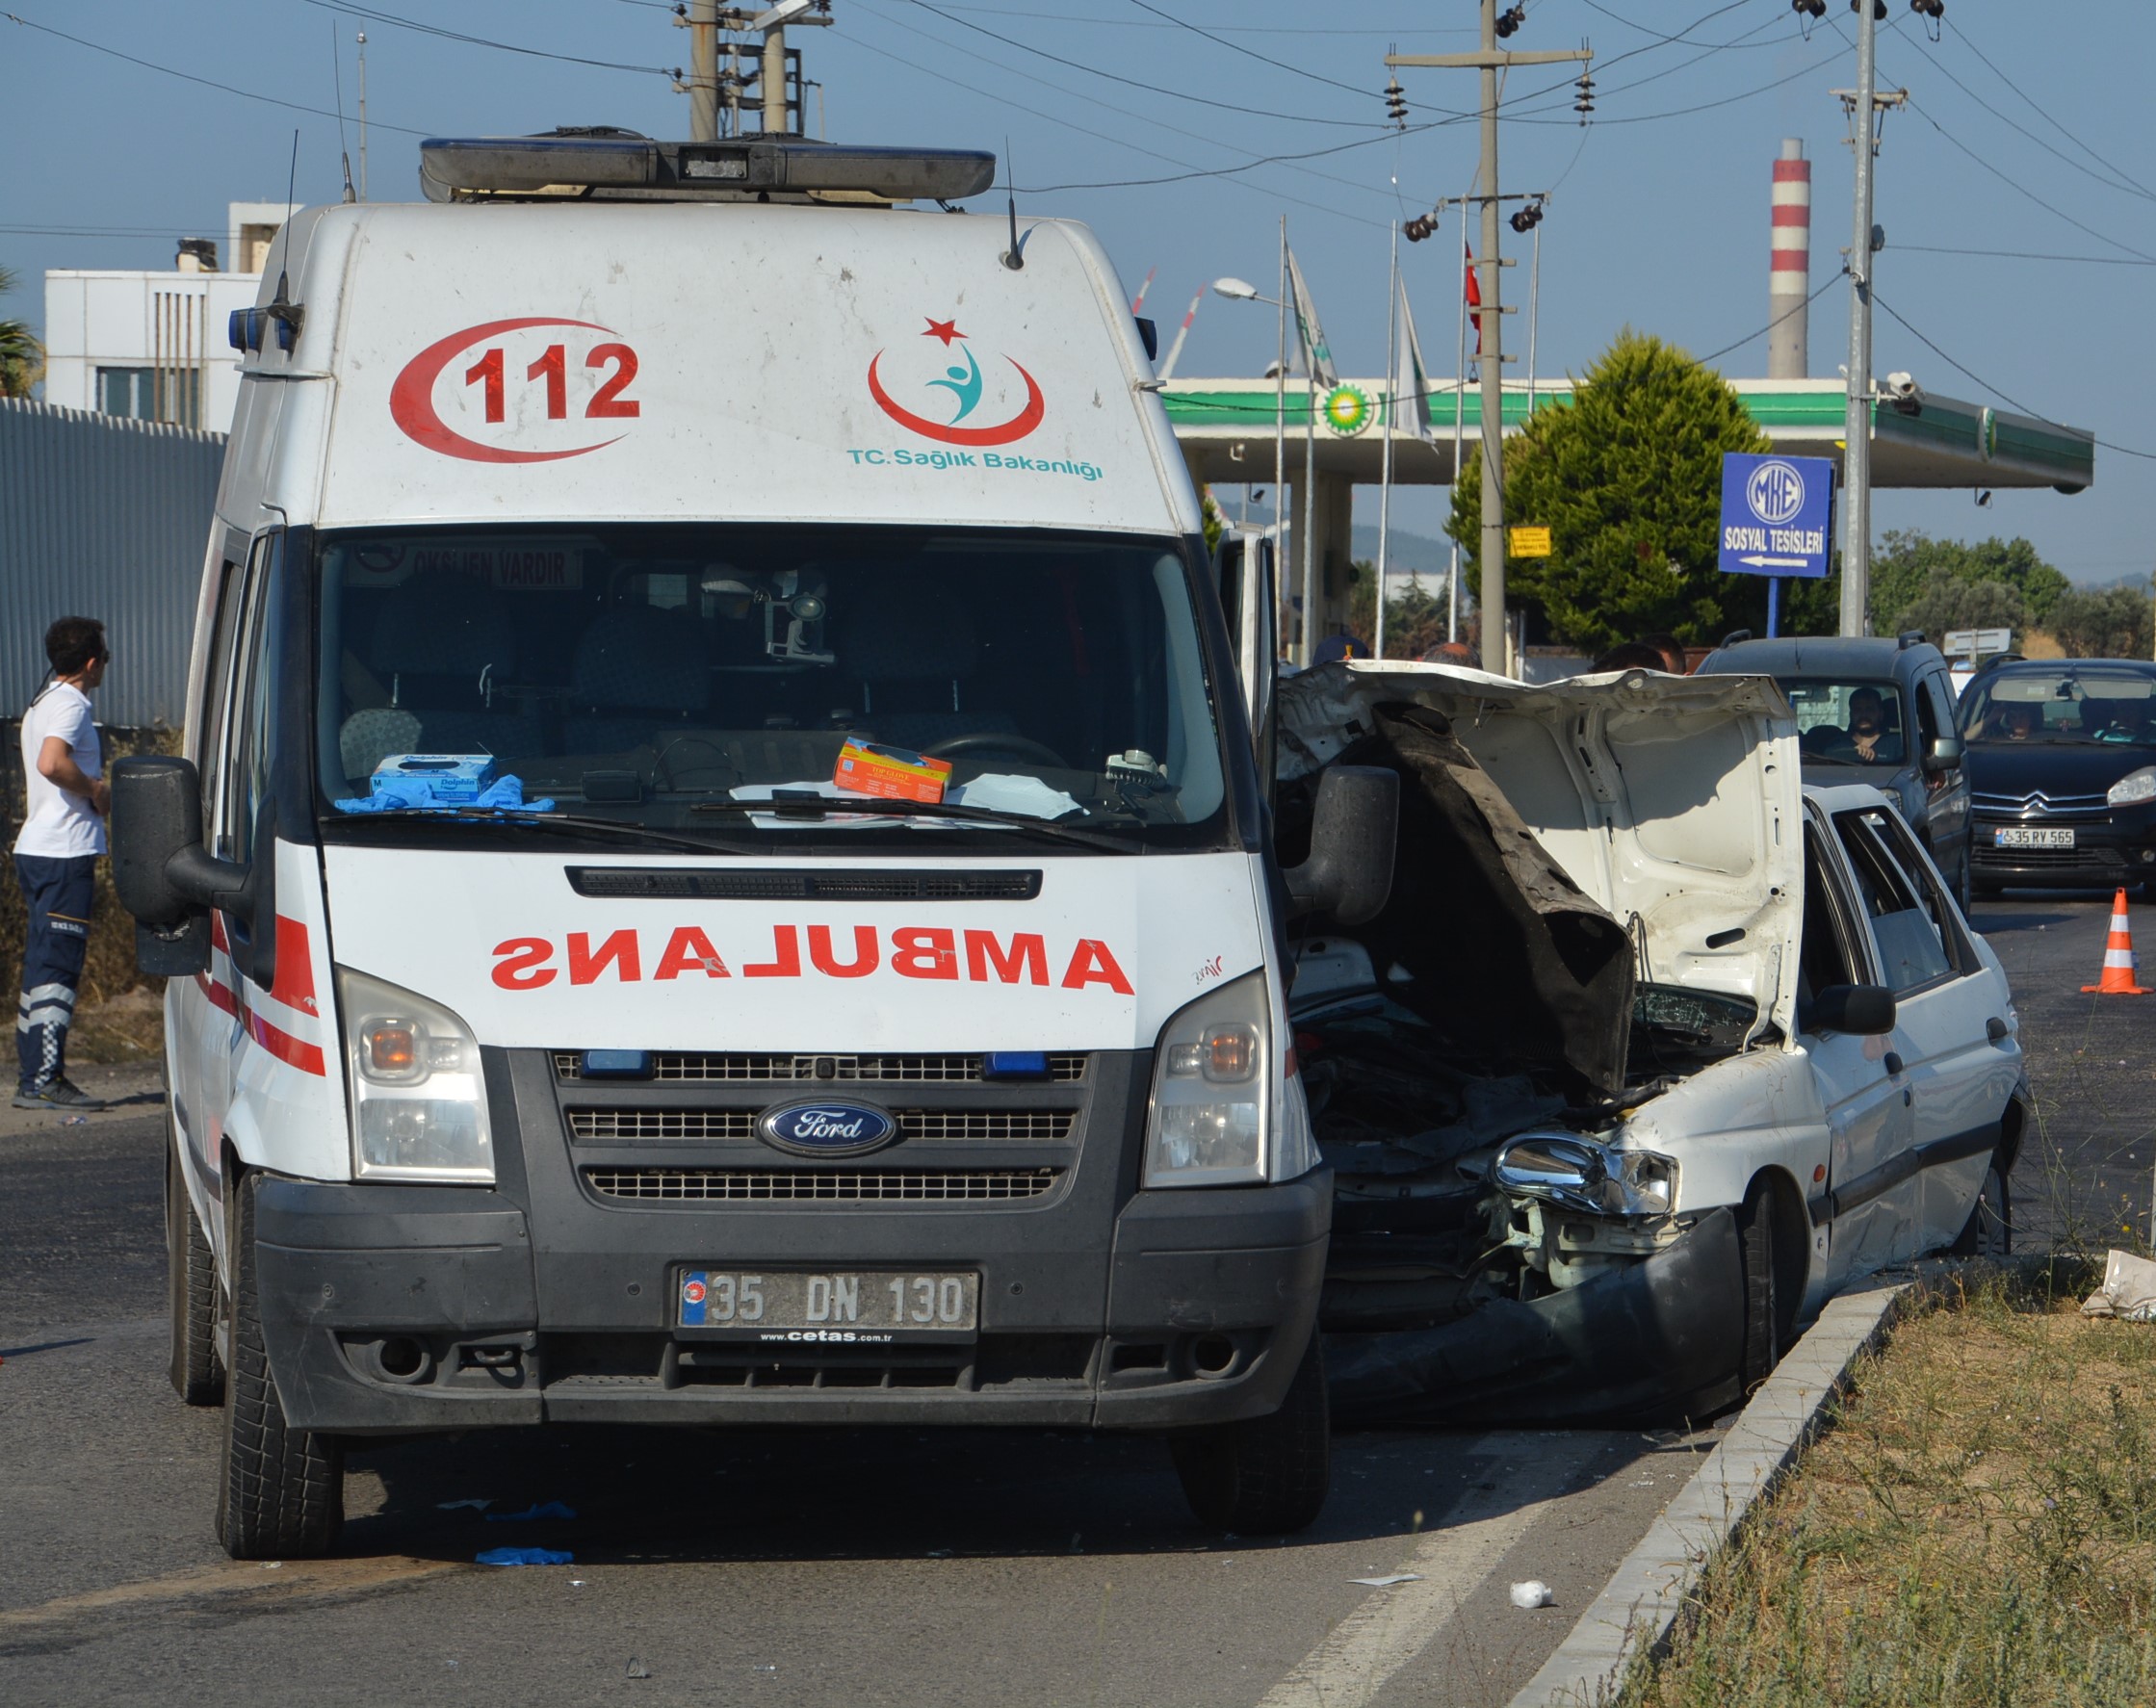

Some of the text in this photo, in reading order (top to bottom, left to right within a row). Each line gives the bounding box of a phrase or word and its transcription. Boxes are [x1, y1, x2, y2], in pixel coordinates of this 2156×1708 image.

[465, 343, 640, 424] 112
[894, 449, 977, 470] Sağlık
[982, 453, 1104, 481] Bakanlığı
[1725, 524, 1825, 555] SOSYAL TESİSLERİ
[498, 551, 565, 584] VARDIR
[374, 779, 382, 788] M
[440, 778, 476, 789] Dolphin
[2015, 831, 2072, 843] 35 RV 565
[793, 1110, 864, 1138] Ford
[712, 1275, 963, 1323] 35 DN 130
[760, 1329, 893, 1343] www.cetas.com.tr
